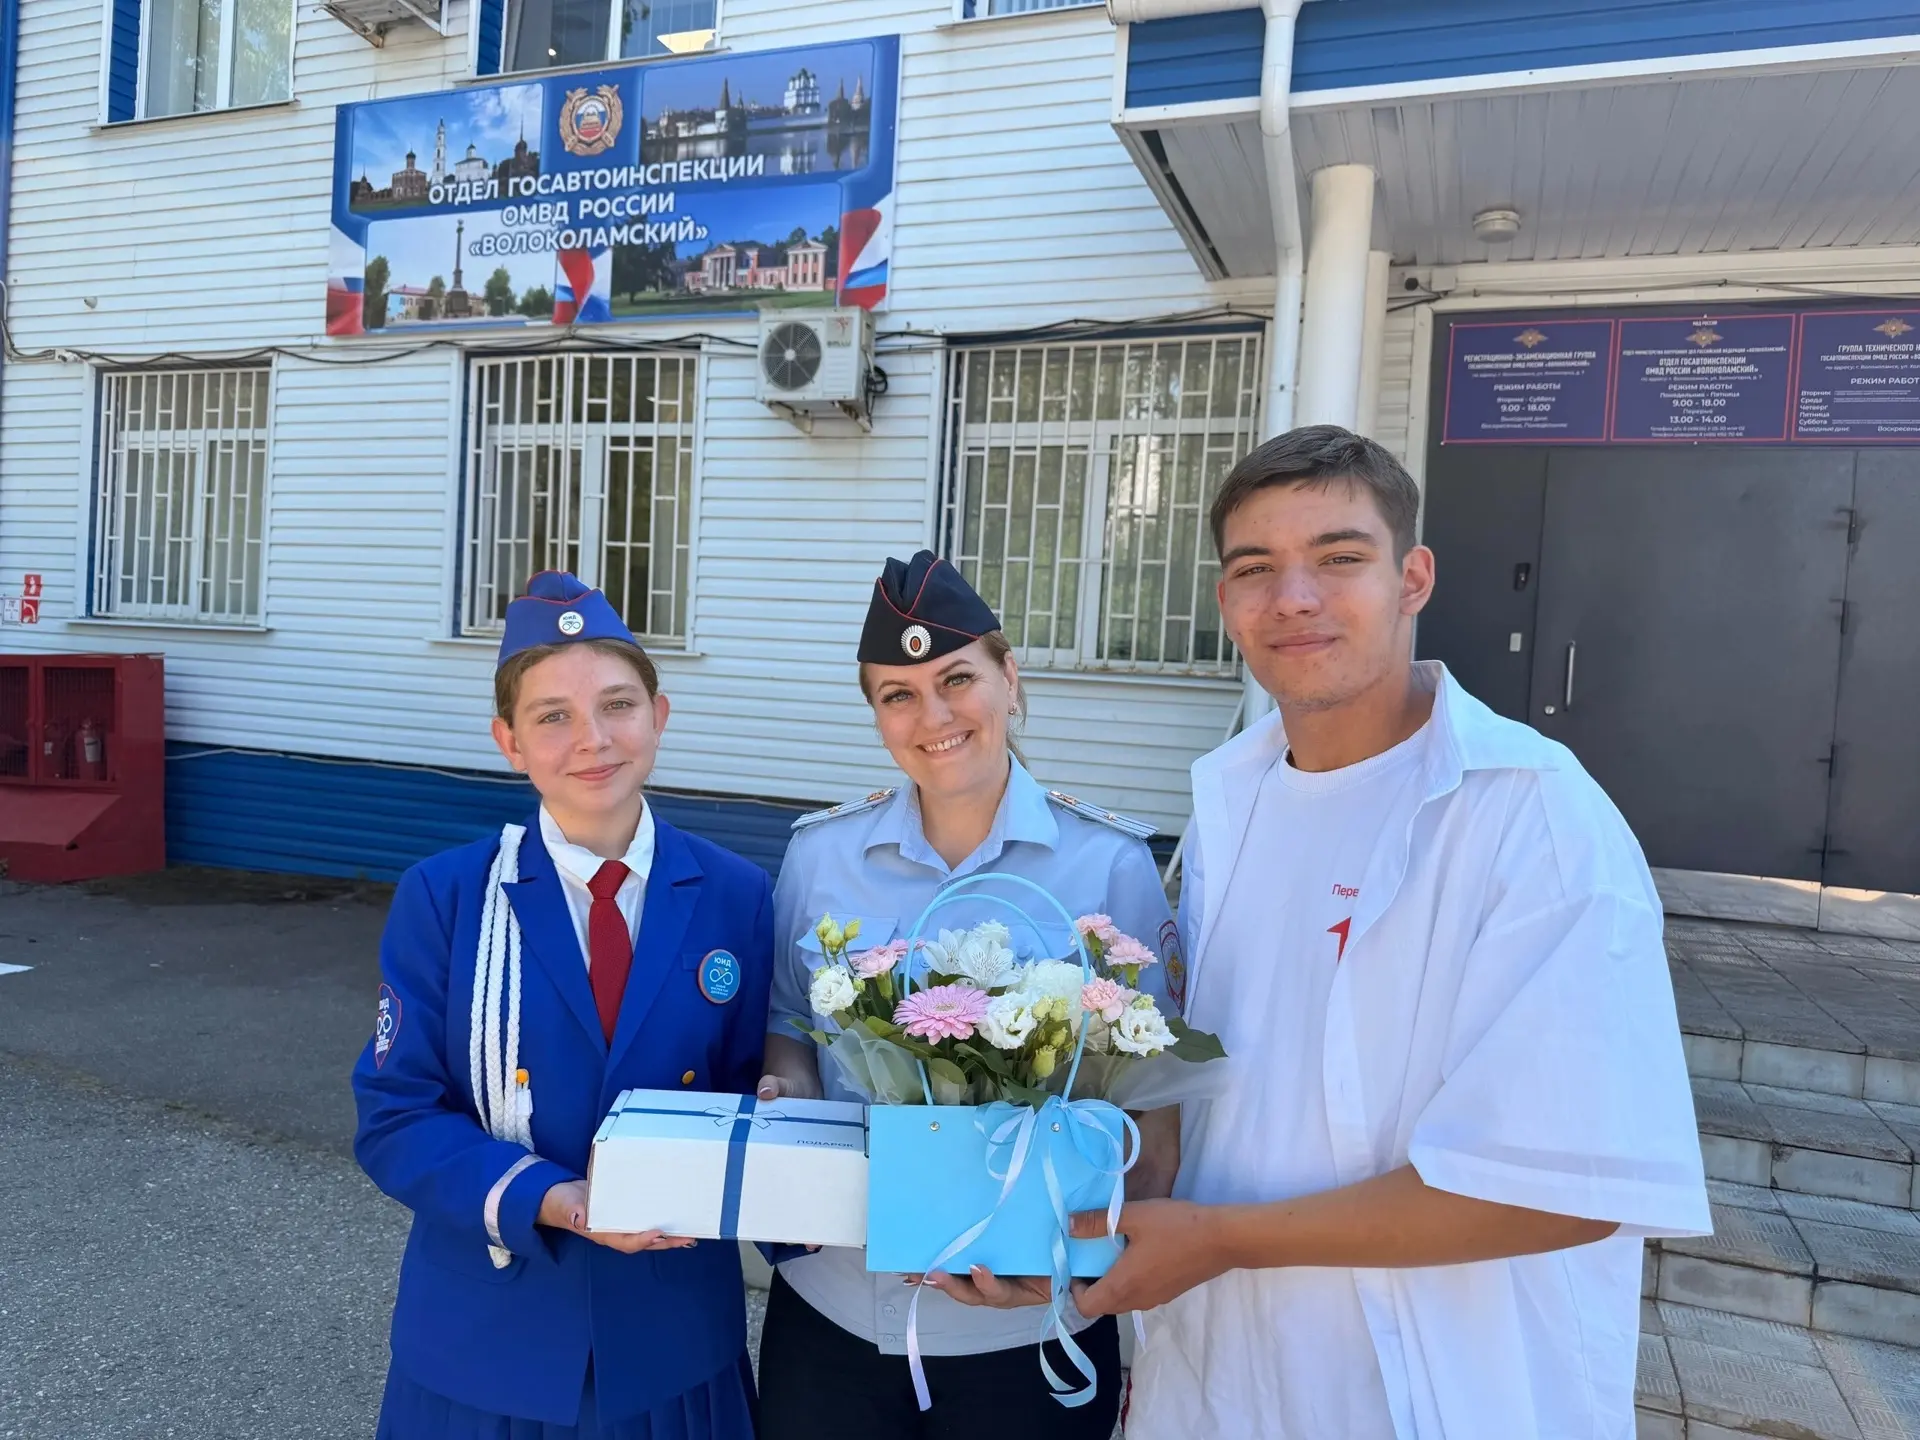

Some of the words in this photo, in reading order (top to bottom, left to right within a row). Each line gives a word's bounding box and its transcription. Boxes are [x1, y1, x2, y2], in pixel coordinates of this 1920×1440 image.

[428, 179, 499, 206] ОТДЕЛ
[508, 154, 764, 198] ГОСАВТОИНСПЕКЦИИ
[502, 200, 569, 226] ОМВД
[579, 191, 675, 220] РОССИИ
[469, 215, 708, 256] «ВОЛОКОЛАМСКИЙ»
[1838, 344, 1862, 353] ГРУППА
[1866, 344, 1914, 352] ТЕХНИЧЕСКОГО
[1659, 358, 1679, 366] ОТДЕЛ
[1680, 356, 1746, 366] ГОСАВТОИНСПЕКЦИИ
[1646, 367, 1664, 375] ОМВД
[1666, 366, 1691, 374] РОССИИ
[1692, 364, 1758, 374] «ВОЛОКОЛАМСКИЙ»
[1701, 398, 1726, 406] 18.00
[1500, 404, 1520, 412] 9.00
[1527, 404, 1551, 412] 18.00
[714, 956, 732, 968] ЮИД
[796, 1139, 854, 1148] ПОДАРОК
